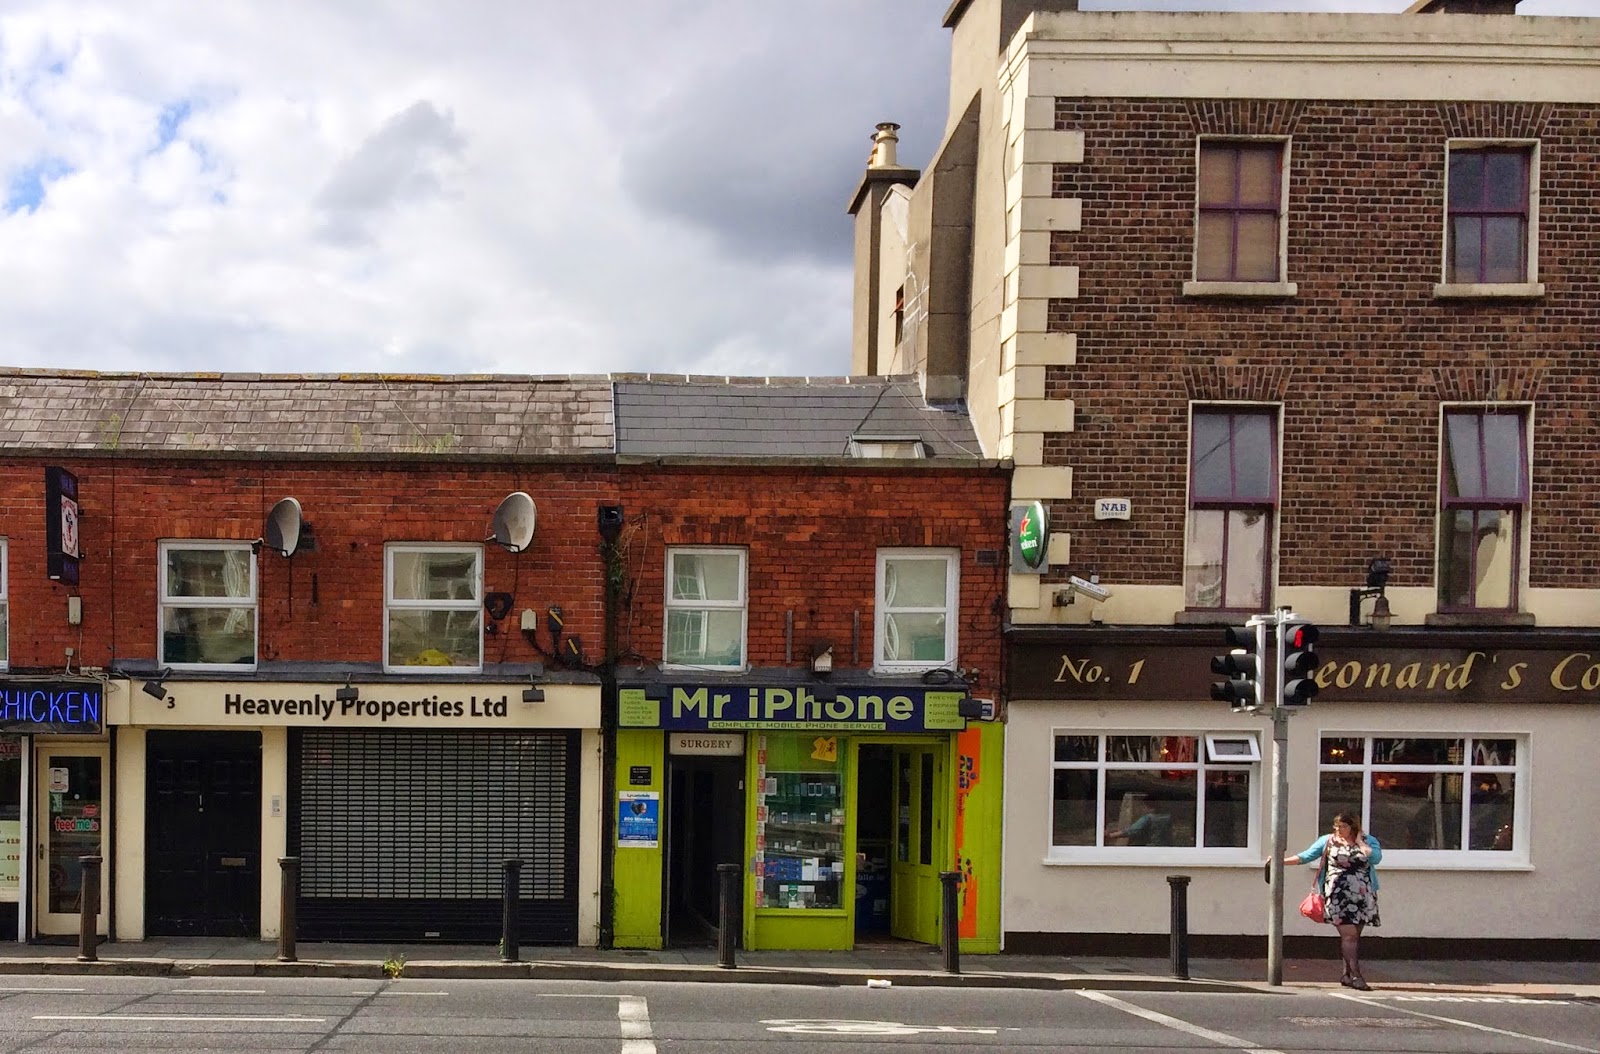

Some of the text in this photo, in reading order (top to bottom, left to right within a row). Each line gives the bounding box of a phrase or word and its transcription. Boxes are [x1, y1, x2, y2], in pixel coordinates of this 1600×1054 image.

[1101, 503, 1127, 511] NAB
[1054, 655, 1110, 683] No.
[1128, 659, 1146, 684] 1
[1314, 651, 1528, 691] eonard's
[0, 690, 99, 723] HICKEN
[167, 694, 508, 722] 3 Heavenly Properties Ltd
[672, 688, 915, 721] Mr iPhone
[680, 739, 733, 749] SURGERY
